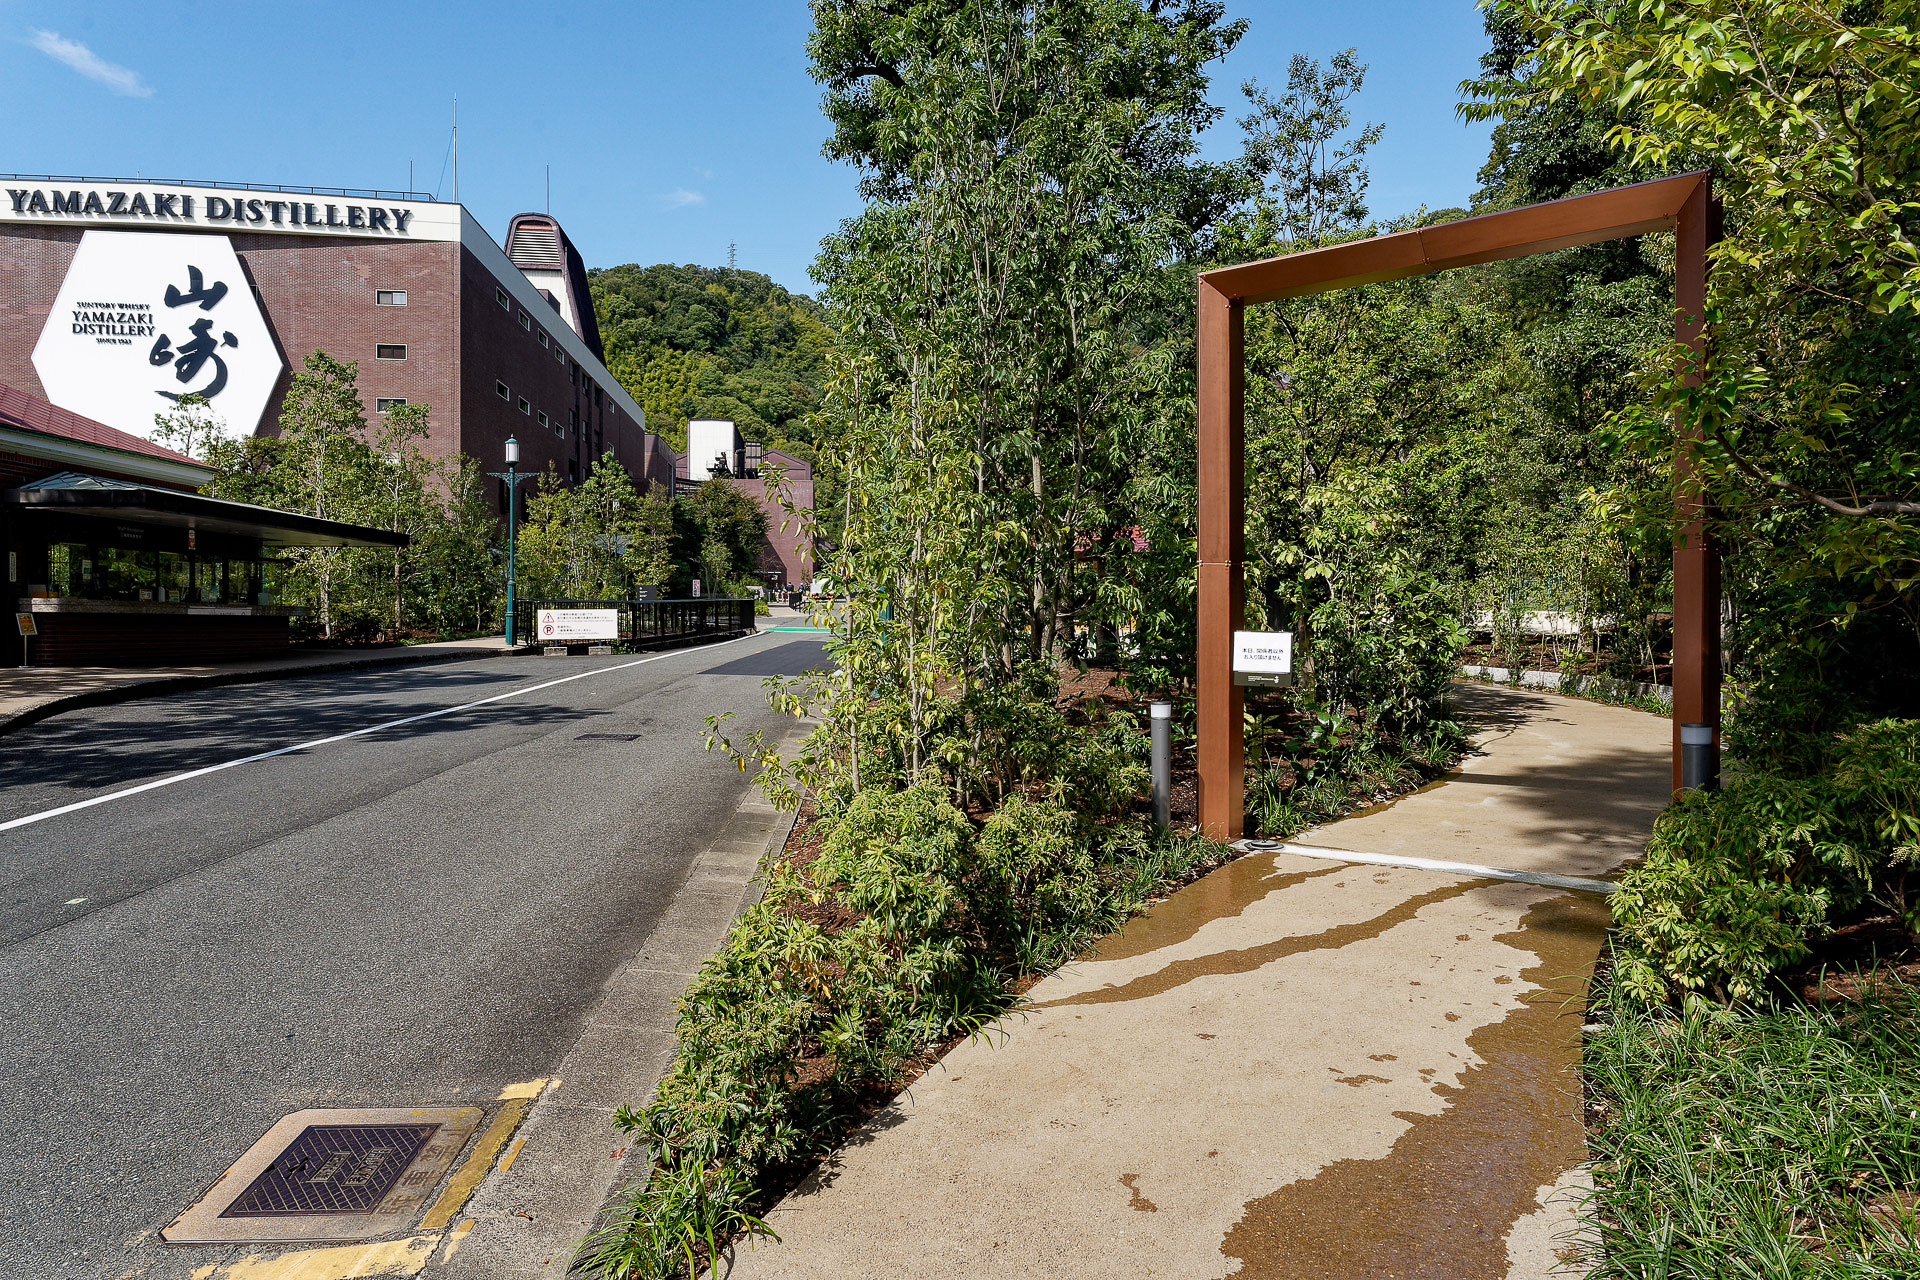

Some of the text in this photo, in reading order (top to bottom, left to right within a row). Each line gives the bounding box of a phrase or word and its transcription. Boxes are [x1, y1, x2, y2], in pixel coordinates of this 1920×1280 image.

[6, 189, 412, 231] YAMAZAKI DISTILLERY
[72, 311, 153, 324] YAMAZAKI
[72, 323, 155, 337] DISTILLERY
